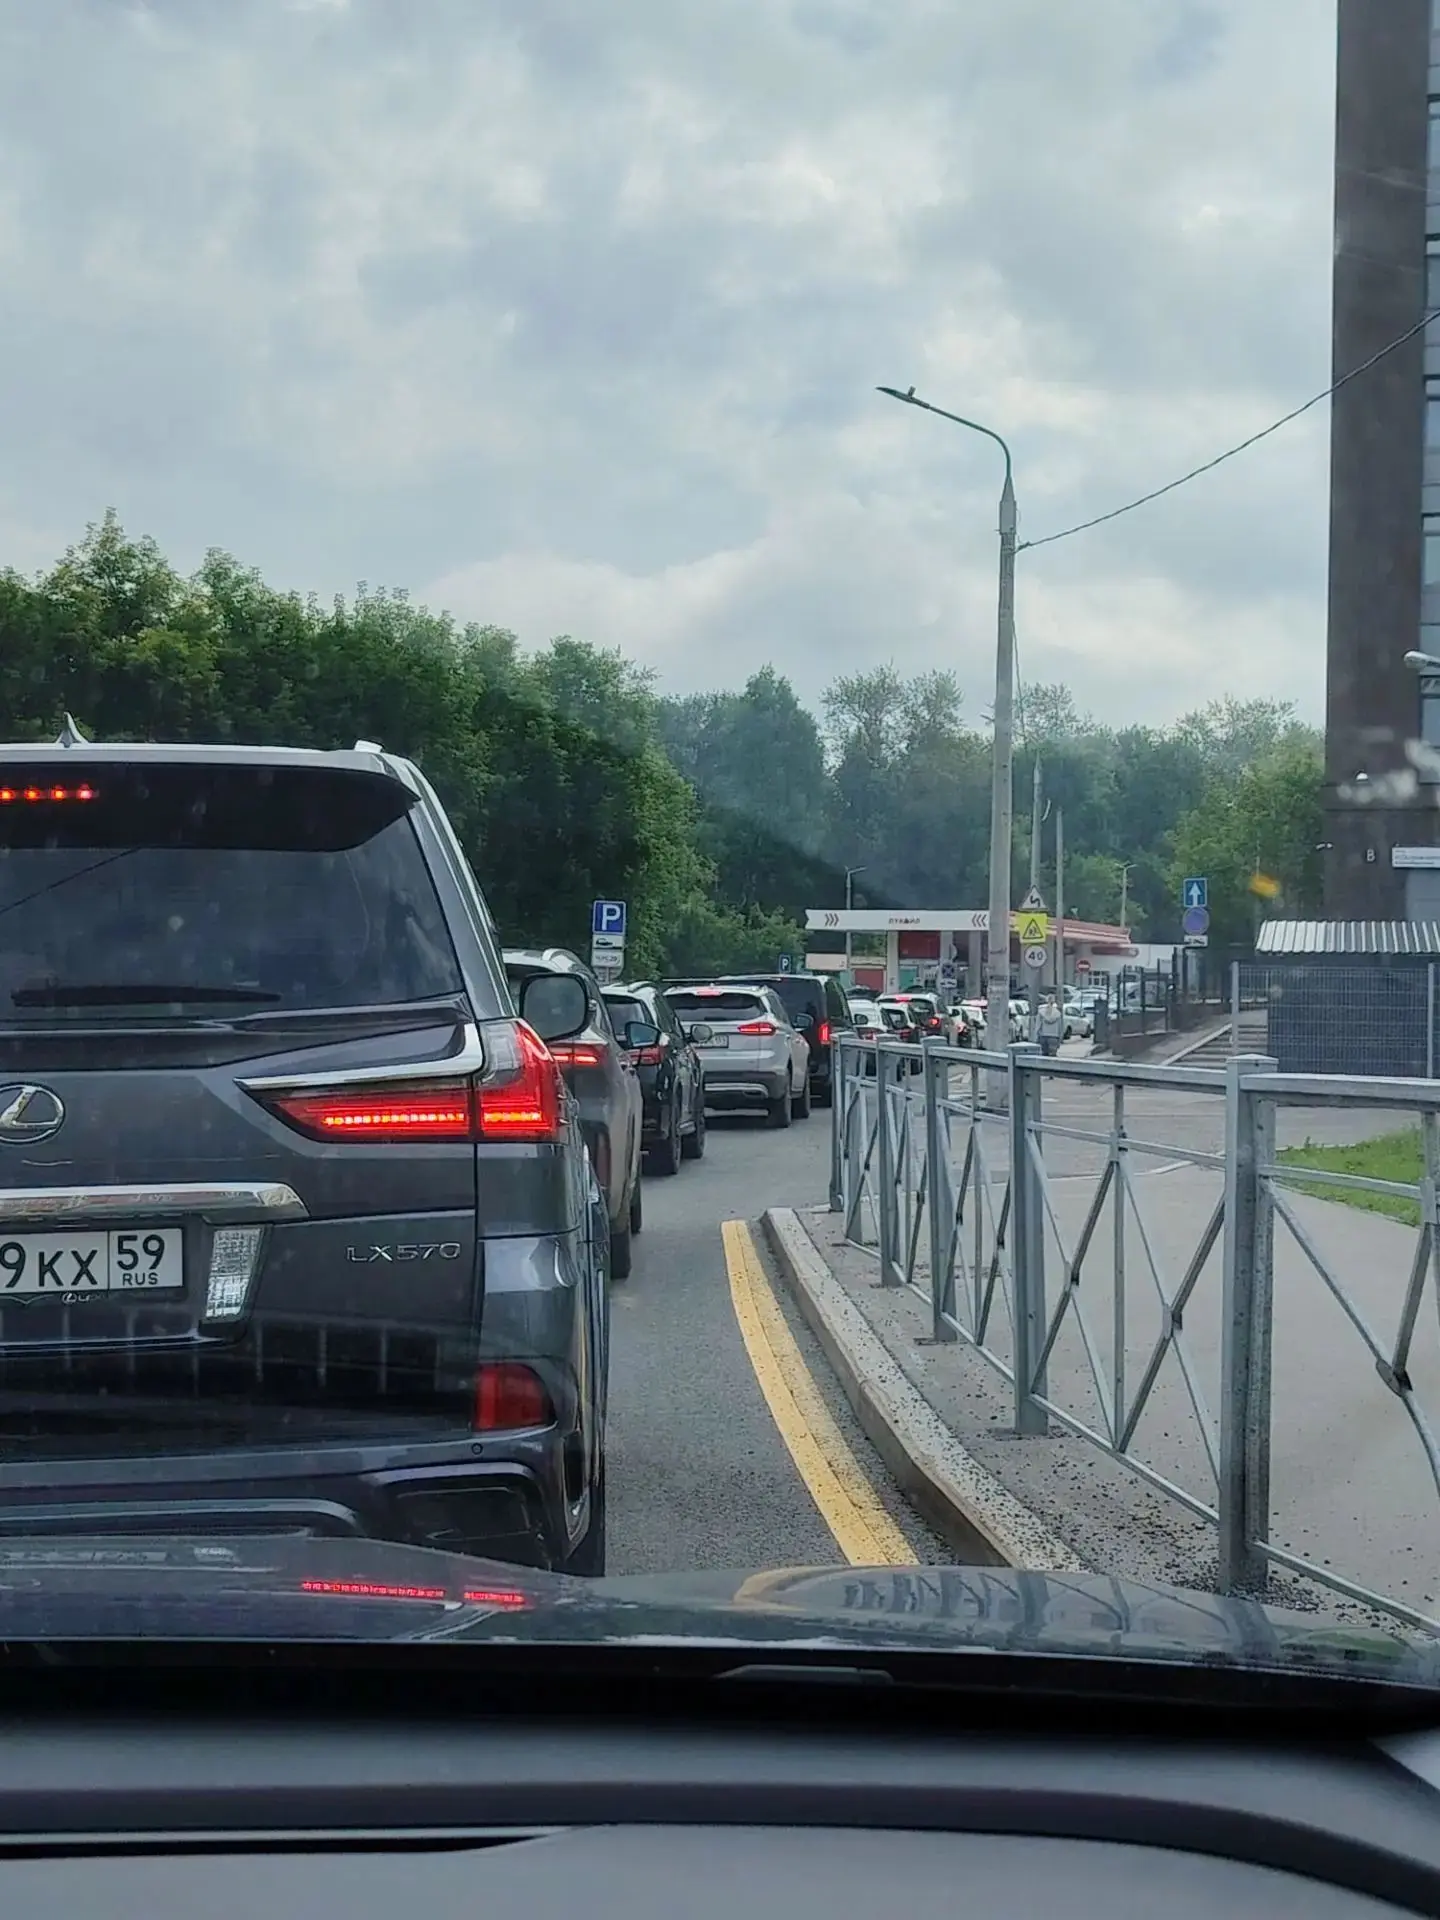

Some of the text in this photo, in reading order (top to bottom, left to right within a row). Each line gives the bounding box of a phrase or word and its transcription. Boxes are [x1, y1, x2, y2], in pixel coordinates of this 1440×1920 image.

[602, 903, 621, 931] P
[781, 957, 789, 968] P
[1029, 951, 1043, 960] 40
[117, 1235, 165, 1270] 59
[122, 1272, 159, 1286] RUS
